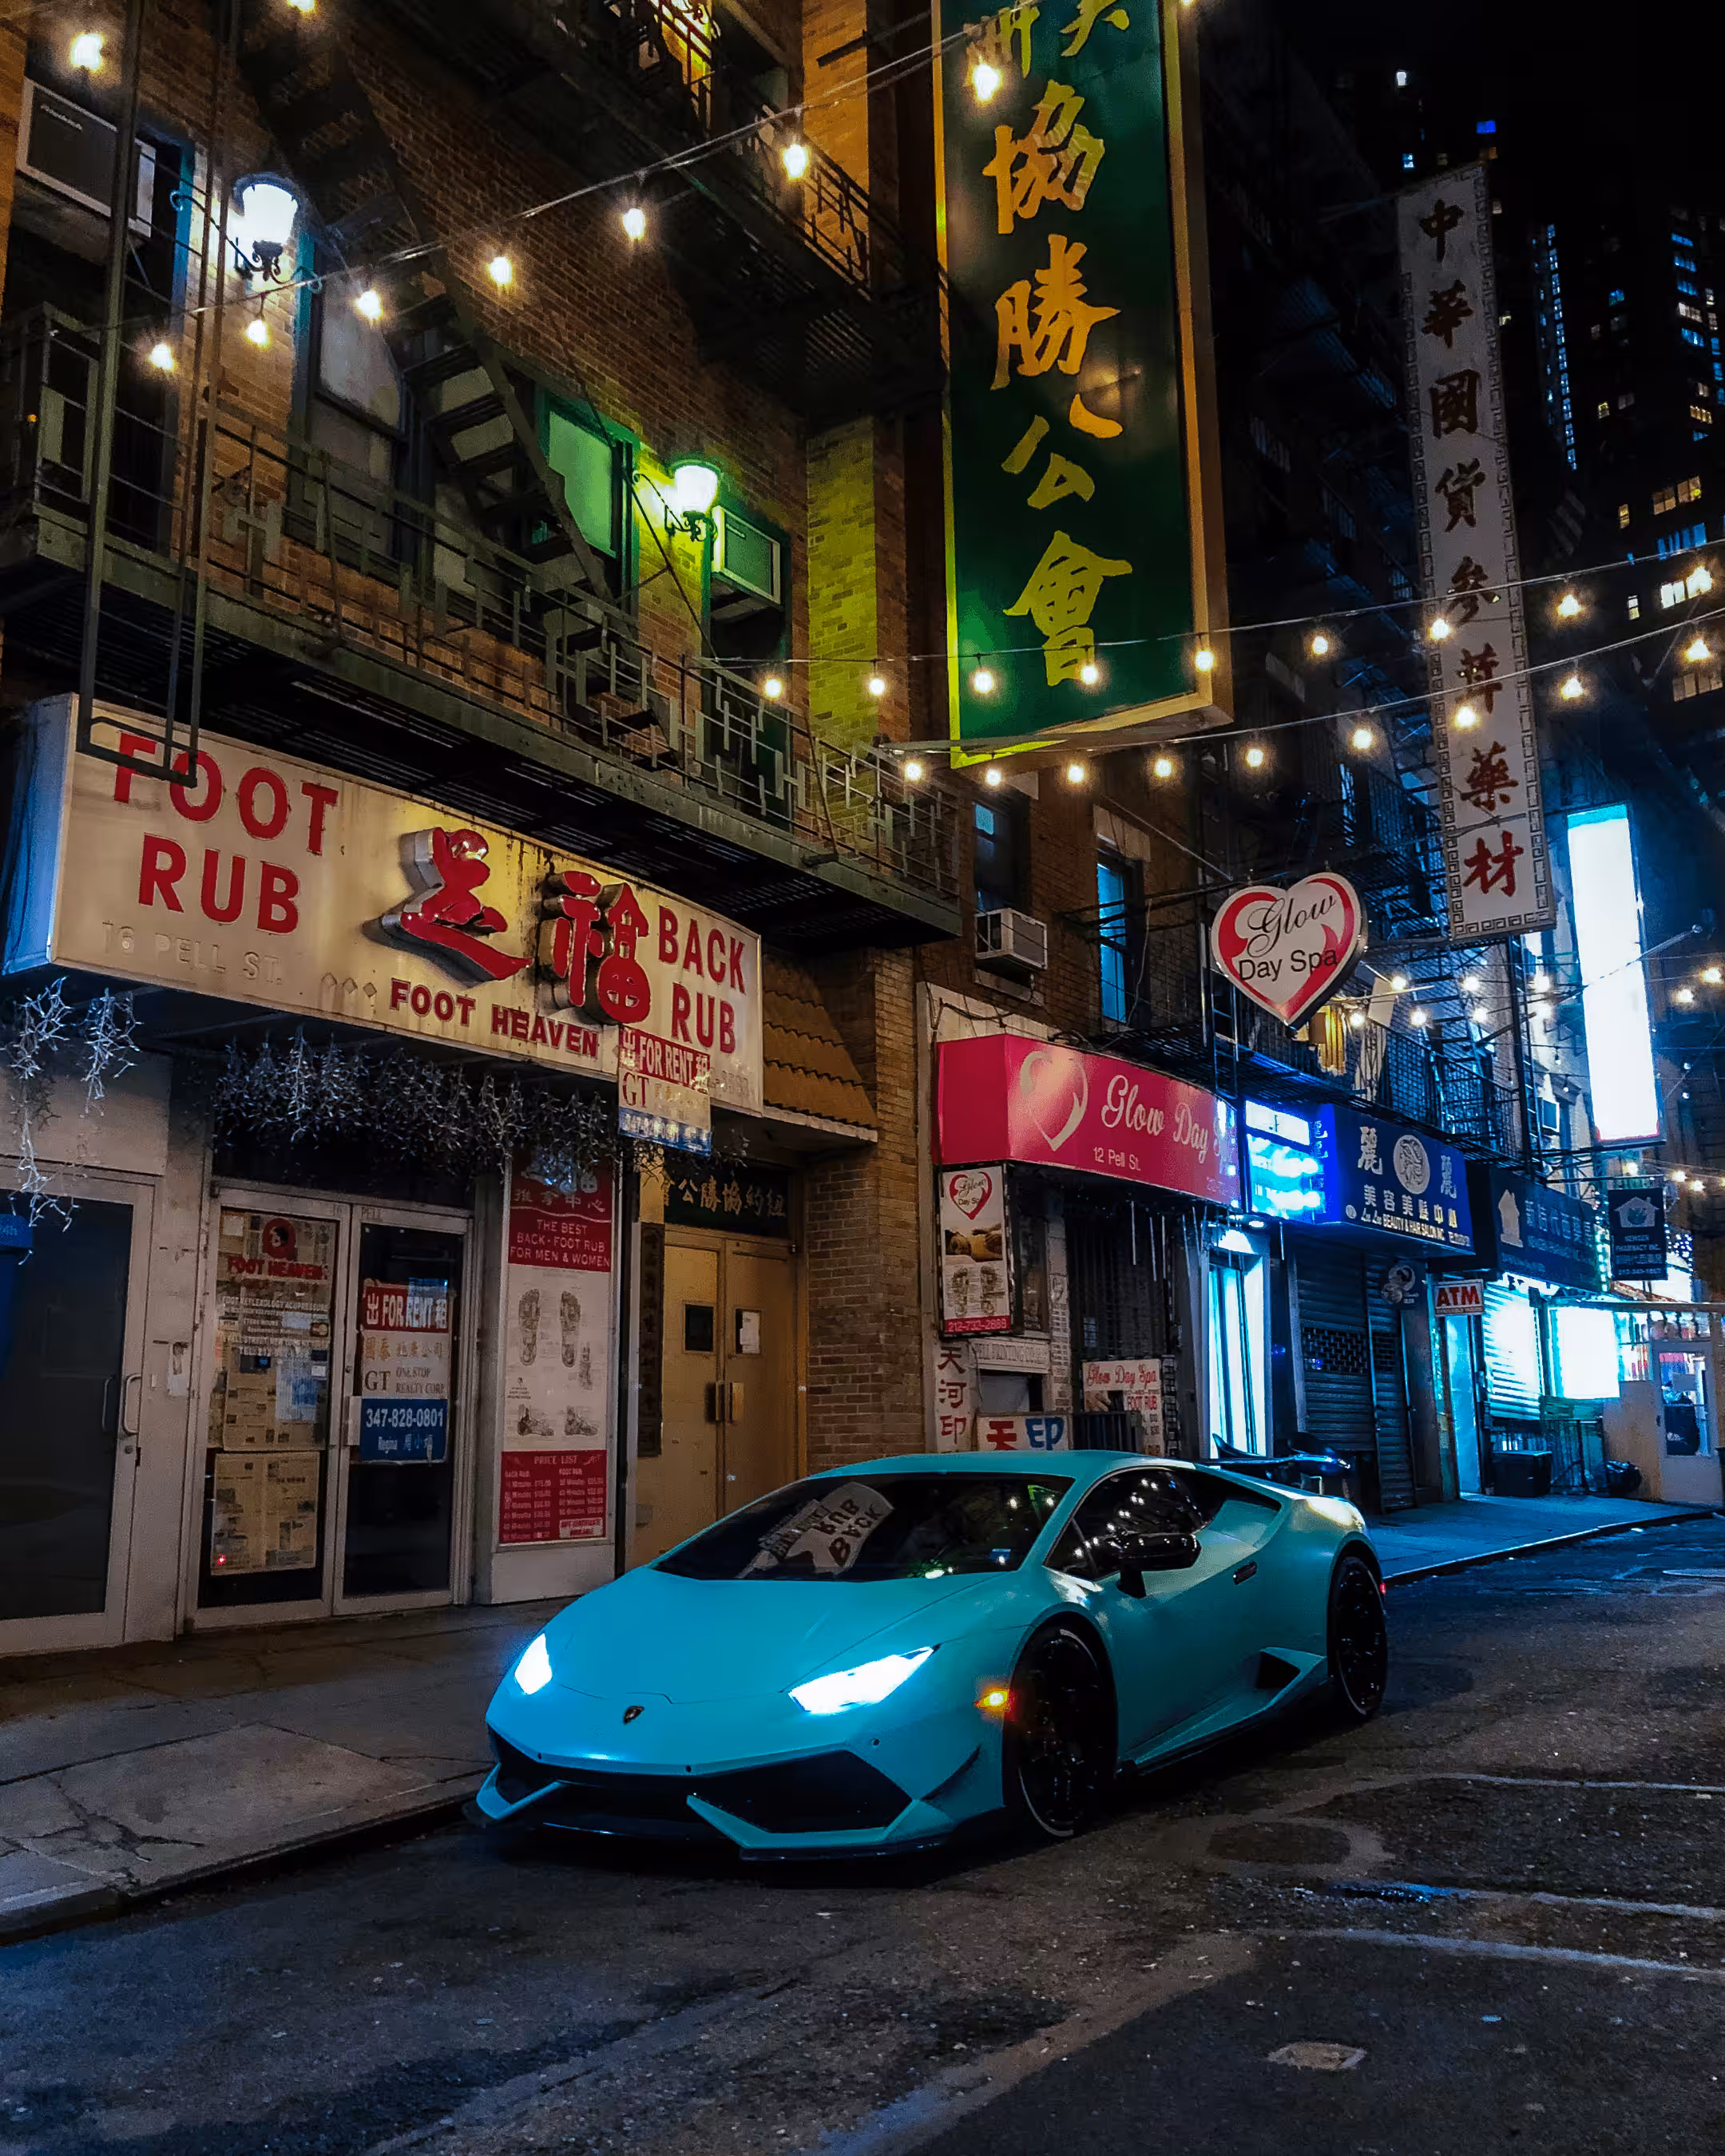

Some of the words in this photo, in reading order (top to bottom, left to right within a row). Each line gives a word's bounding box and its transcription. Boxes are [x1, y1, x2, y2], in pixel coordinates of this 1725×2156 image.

[113, 731, 339, 856] FOOT
[137, 832, 301, 935] RUB
[1247, 893, 1337, 957] Glow
[155, 933, 227, 974] PELL
[657, 906, 747, 997] BACK
[1239, 951, 1284, 984] Day
[1290, 948, 1339, 977] Spa
[391, 978, 476, 1028] FOOT
[491, 1005, 599, 1058] HEAVEN
[671, 982, 736, 1056] RUB
[639, 1036, 663, 1076] FOR
[664, 1044, 694, 1087] RENT
[622, 1072, 649, 1108] GT
[1100, 1074, 1165, 1136] Glow
[1172, 1101, 1209, 1164] Day
[1093, 1147, 1104, 1163] 12
[1108, 1149, 1126, 1167] Pell
[517, 1232, 546, 1246] BACK
[553, 1236, 581, 1250] FOOT
[585, 1240, 605, 1252] RUB
[537, 1219, 558, 1232] THE
[561, 1223, 588, 1235] BEST
[510, 1246, 531, 1258] FOR
[535, 1250, 559, 1262] MEN
[562, 1253, 569, 1262] &
[572, 1253, 610, 1268] WOMEN
[382, 1294, 404, 1327] FOR
[405, 1296, 434, 1329] RENT
[1437, 1285, 1480, 1307] ATM
[364, 1370, 391, 1391] GT
[1115, 1365, 1136, 1389] Day
[1138, 1363, 1157, 1389] Spa
[938, 1346, 966, 1445] 天河印
[366, 1407, 443, 1428] 347-828-0801
[533, 1455, 557, 1465] PRICE
[561, 1455, 578, 1464] LIST
